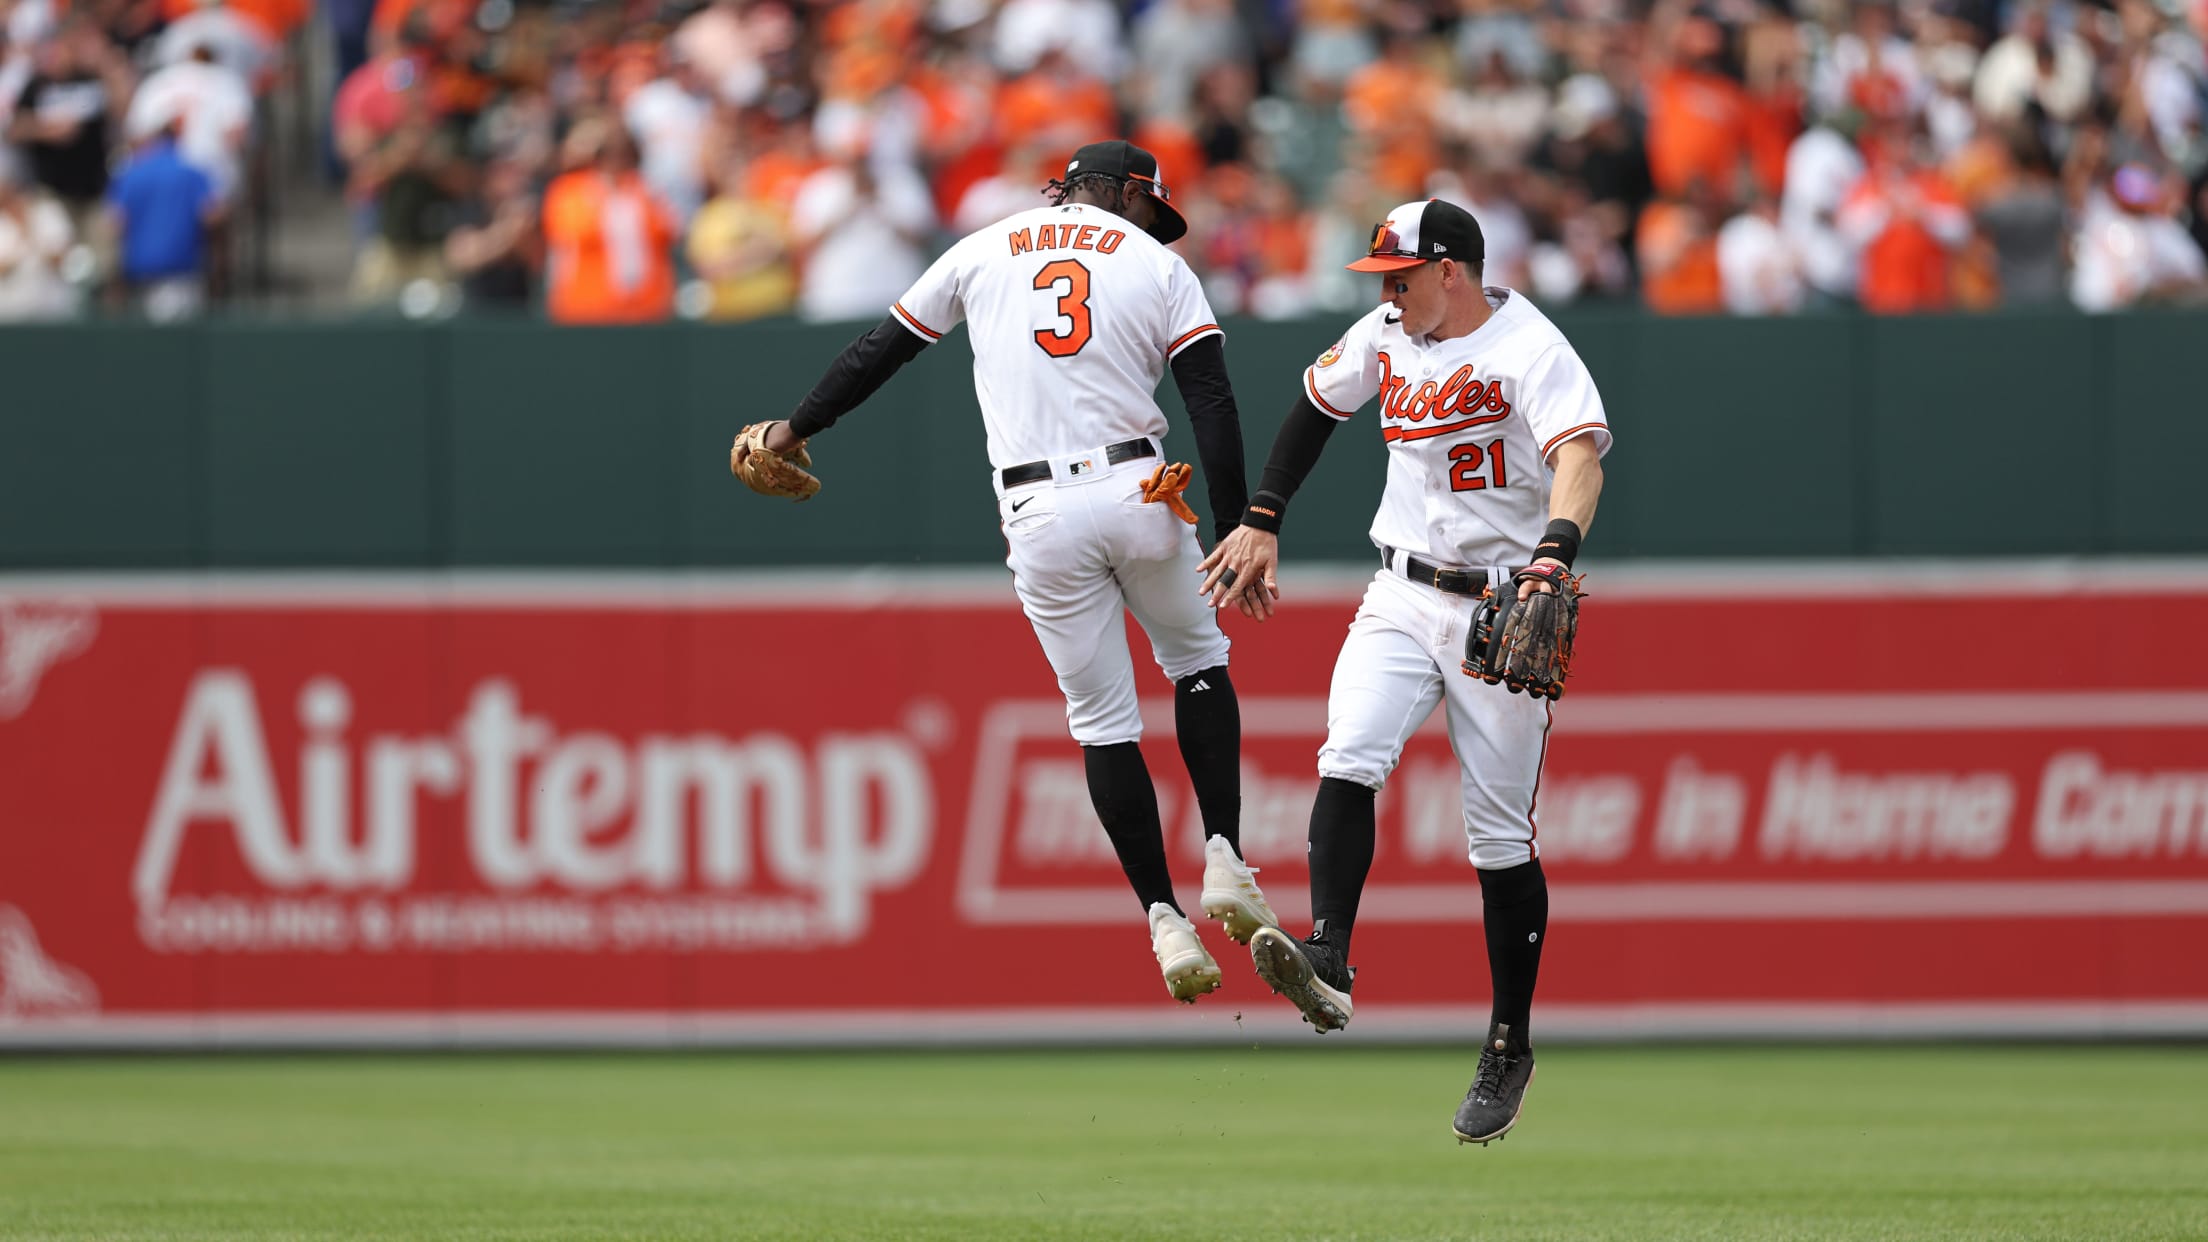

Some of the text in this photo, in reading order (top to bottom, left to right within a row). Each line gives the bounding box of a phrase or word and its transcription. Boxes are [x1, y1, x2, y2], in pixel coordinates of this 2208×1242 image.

[1008, 223, 1126, 256] MATEO
[1032, 258, 1092, 359] 3
[1447, 438, 1507, 492] 21
[133, 669, 934, 942] Airtemp
